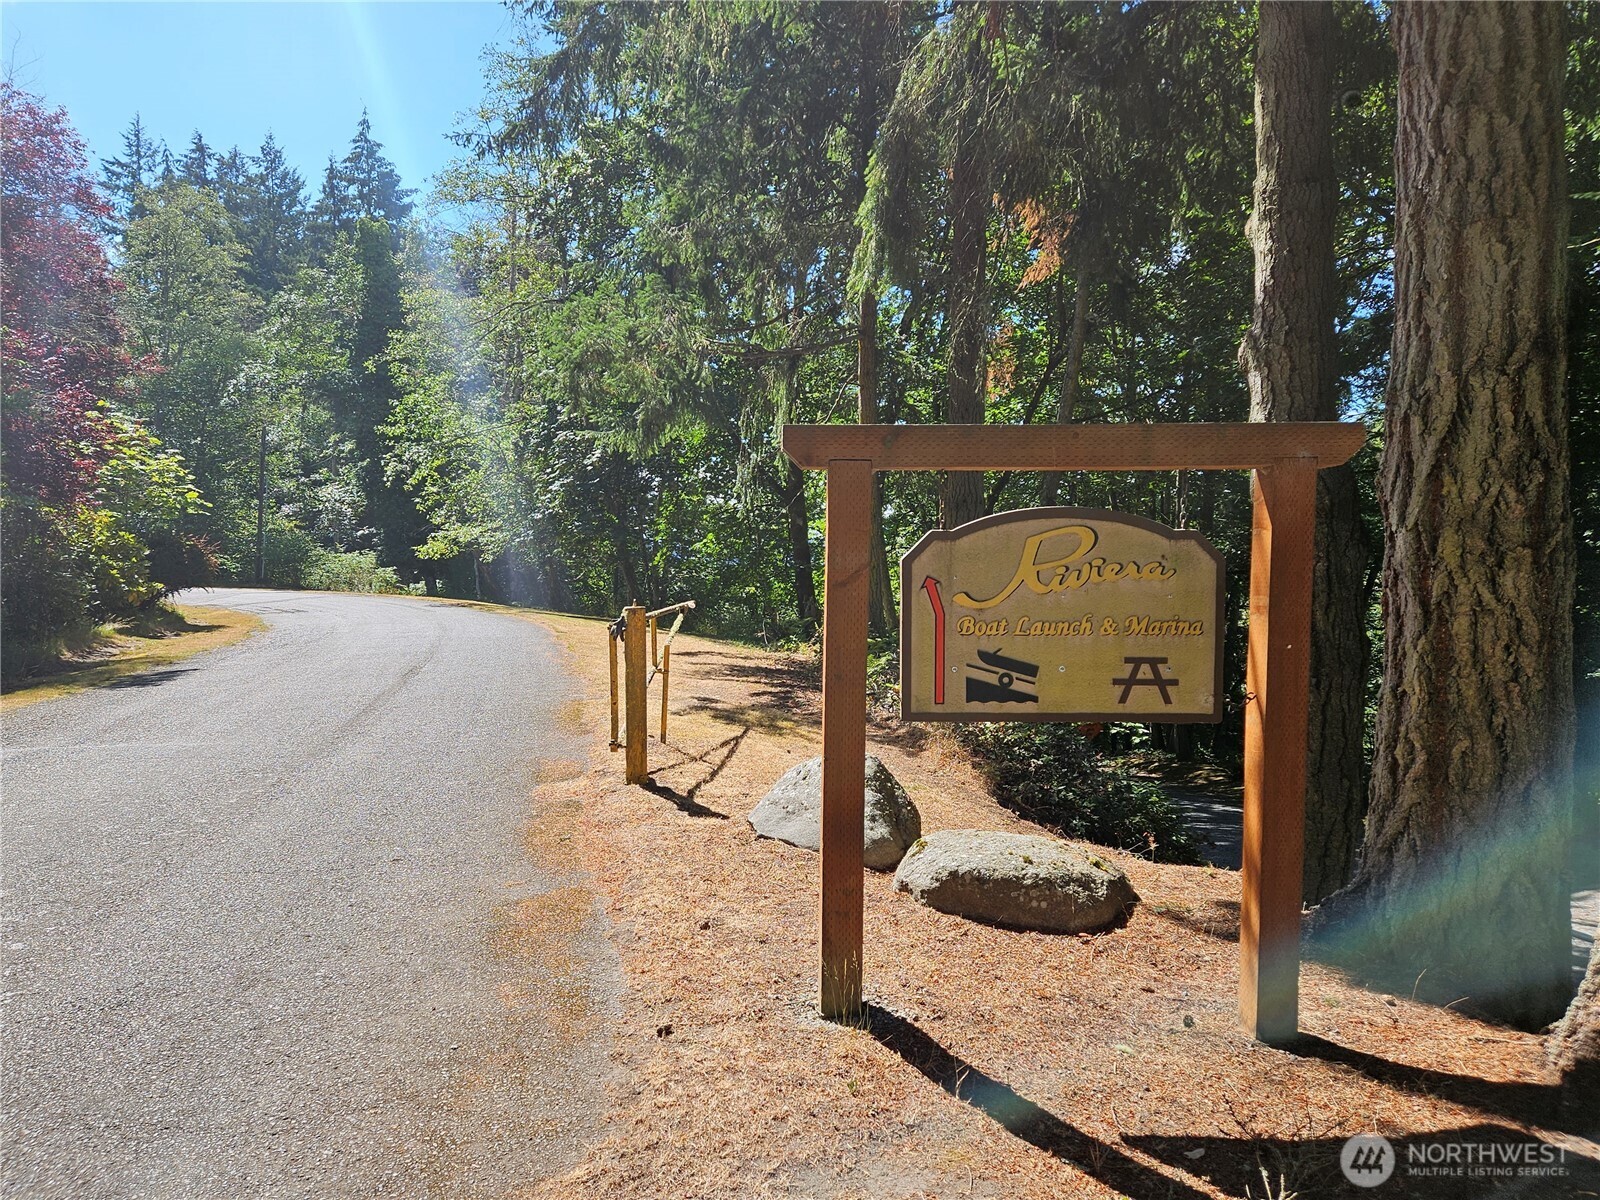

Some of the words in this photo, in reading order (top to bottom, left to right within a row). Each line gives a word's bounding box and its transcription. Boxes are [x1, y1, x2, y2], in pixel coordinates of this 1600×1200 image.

[952, 525, 1177, 609] Riviera
[957, 615, 1008, 637] Boat
[1013, 614, 1093, 637] Launch
[1100, 616, 1119, 637] &
[1123, 616, 1204, 637] Marina
